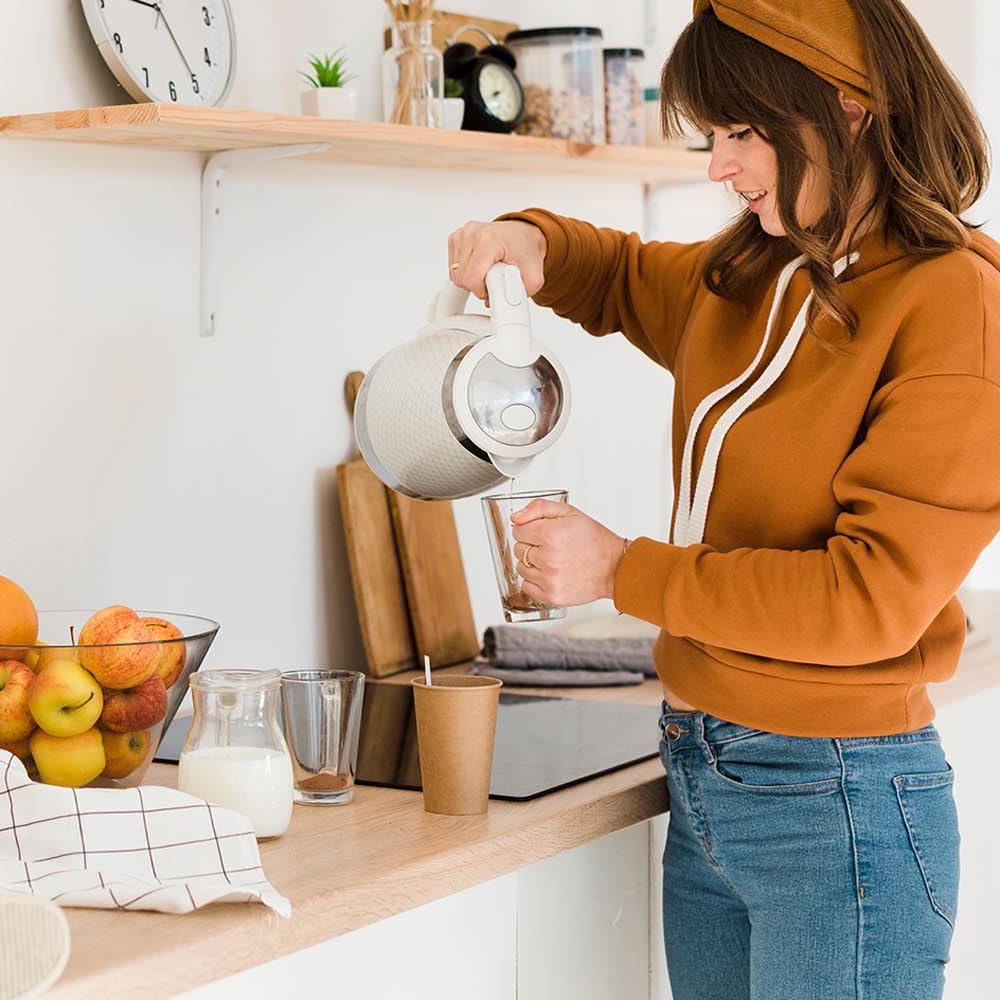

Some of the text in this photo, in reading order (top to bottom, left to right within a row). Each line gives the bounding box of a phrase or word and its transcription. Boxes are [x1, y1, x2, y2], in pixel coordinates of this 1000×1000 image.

[202, 7, 211, 26] 3
[204, 48, 211, 66] 4
[142, 67, 149, 88] 7
[191, 74, 200, 94] 5
[169, 81, 177, 101] 6
